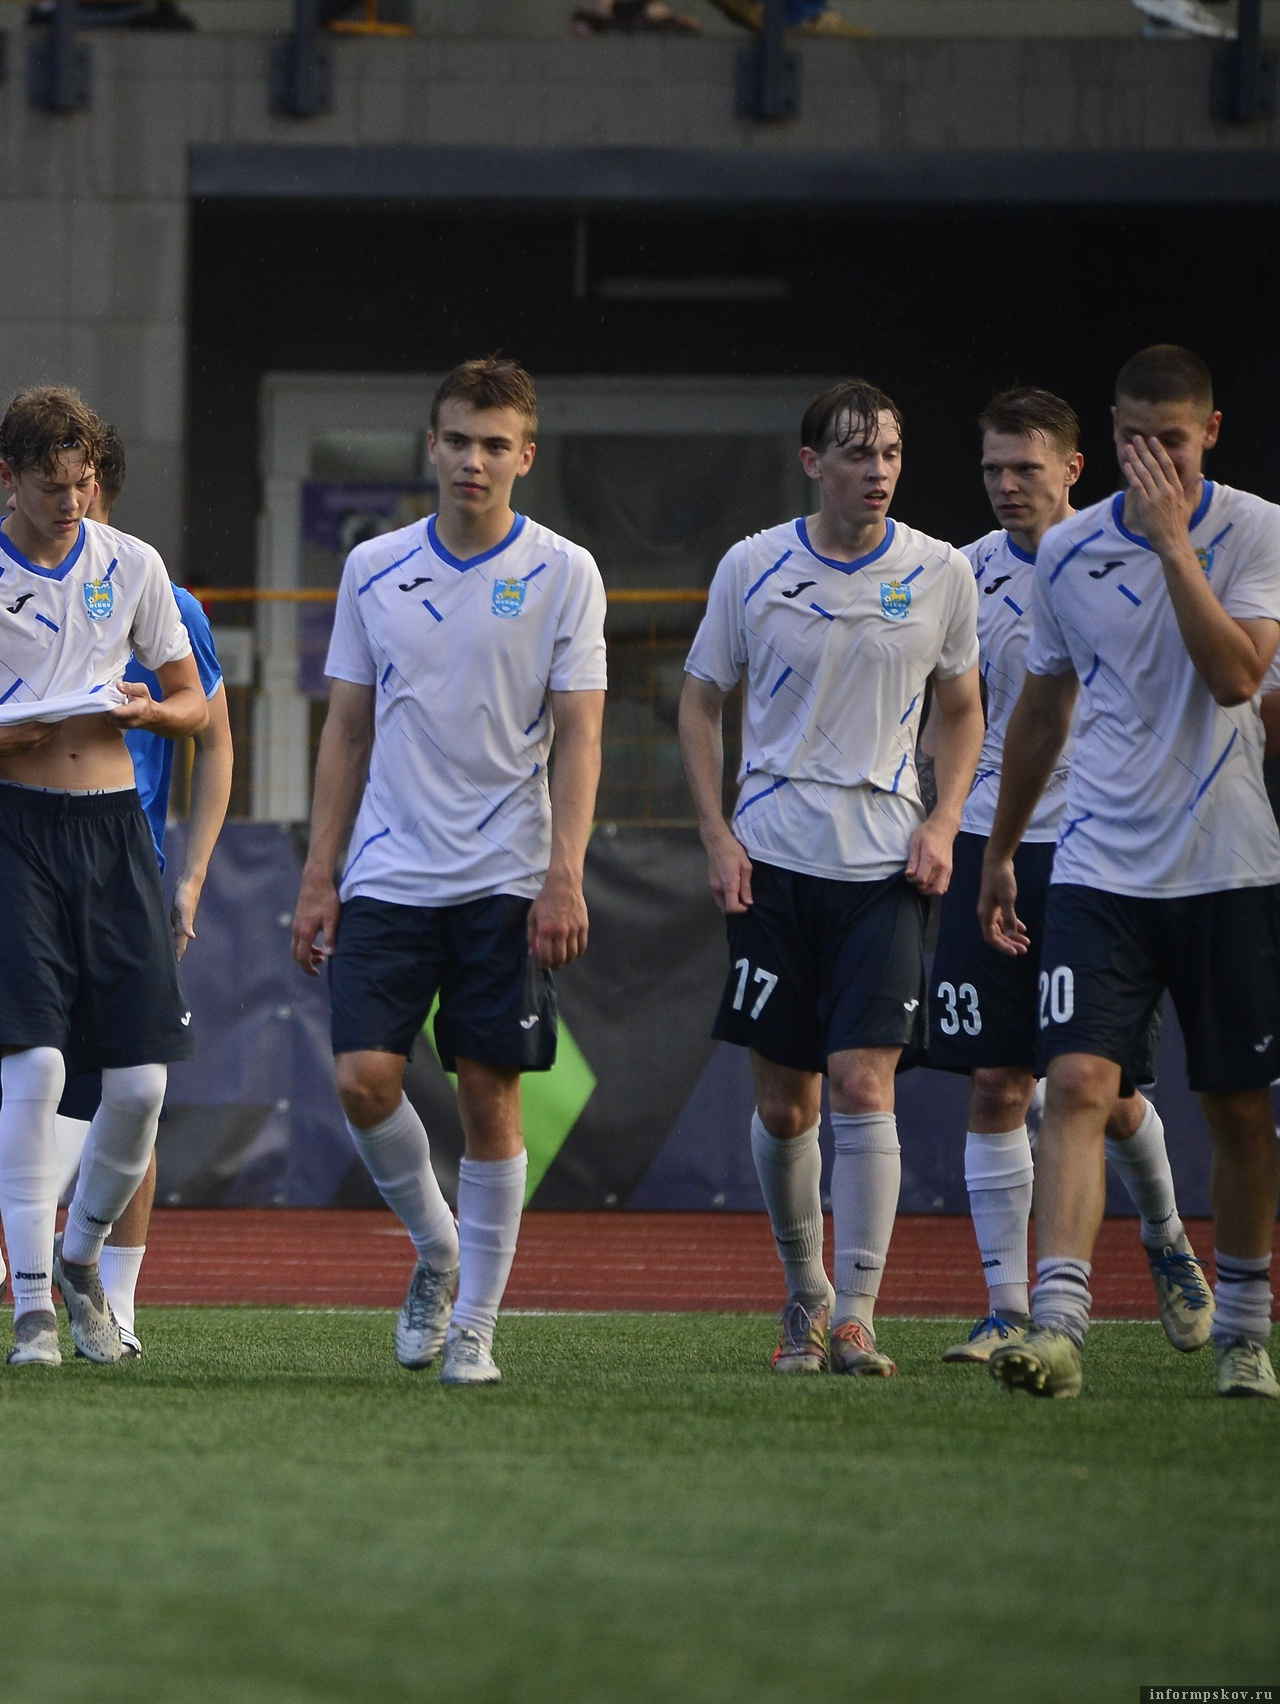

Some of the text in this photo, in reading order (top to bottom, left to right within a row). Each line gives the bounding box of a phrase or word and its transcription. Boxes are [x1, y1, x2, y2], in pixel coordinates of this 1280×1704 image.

[732, 957, 779, 1020] 17
[937, 981, 982, 1036] 33
[1039, 965, 1074, 1031] 20
